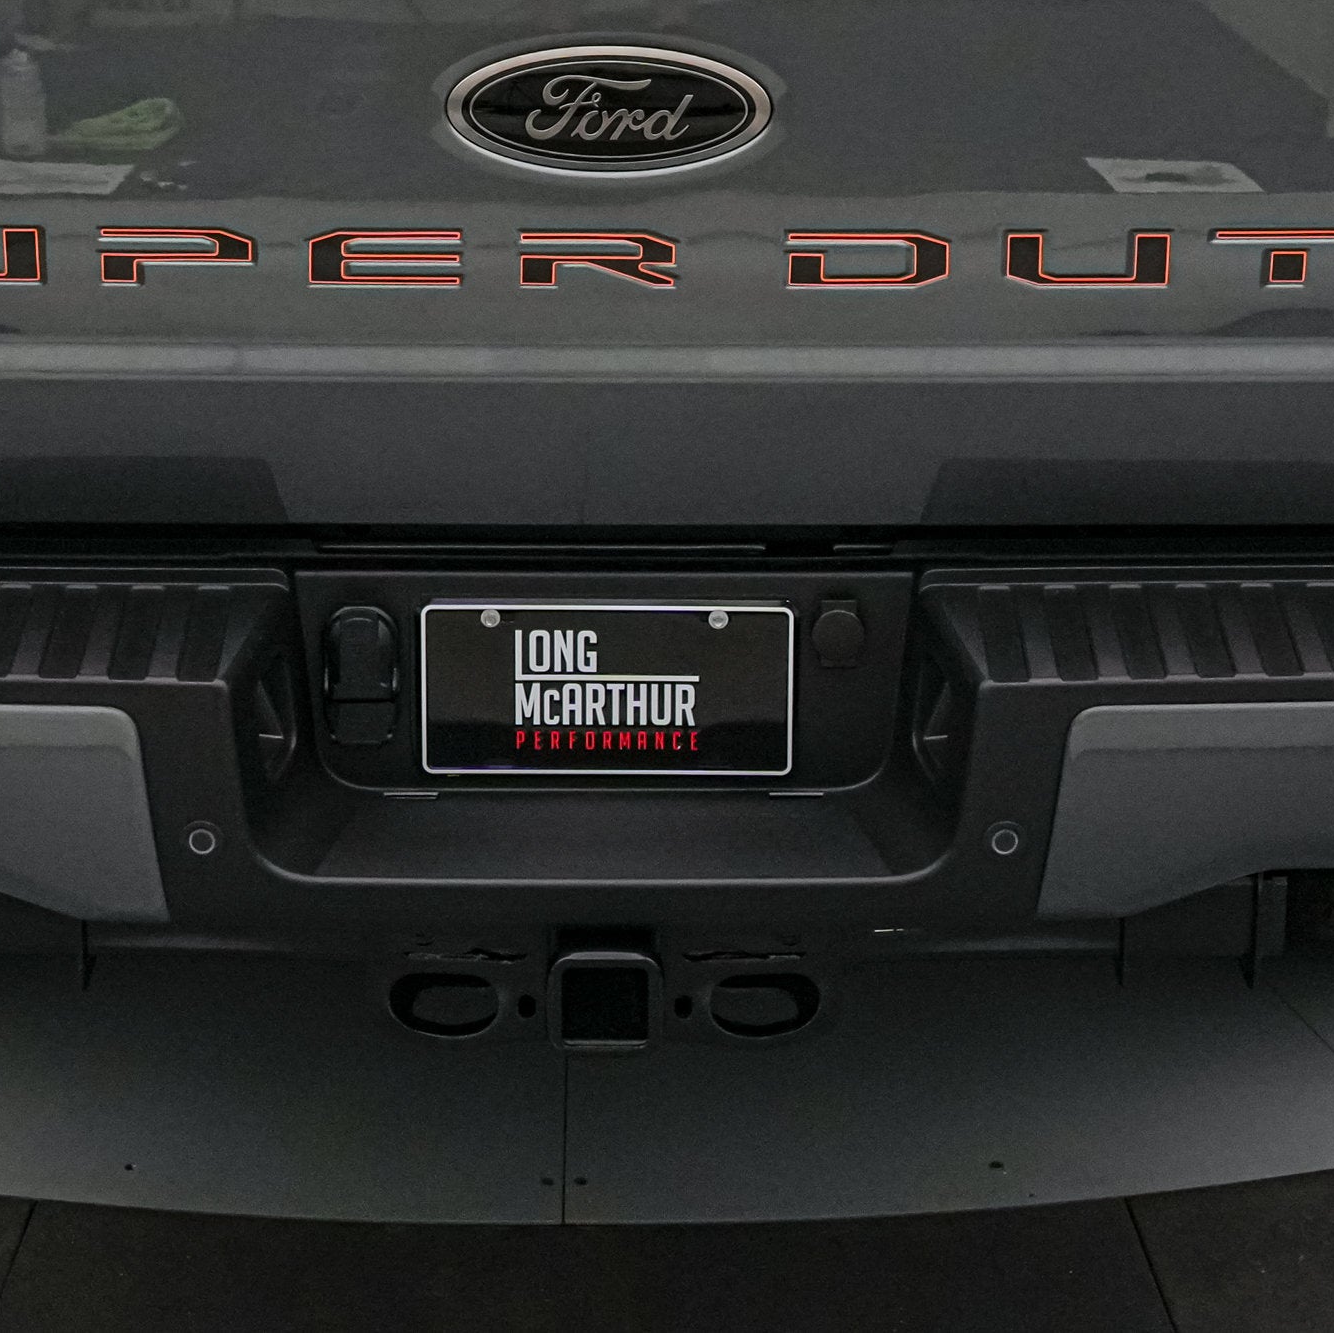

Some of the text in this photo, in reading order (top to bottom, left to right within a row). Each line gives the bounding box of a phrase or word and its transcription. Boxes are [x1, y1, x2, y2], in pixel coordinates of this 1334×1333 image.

[525, 74, 694, 141] Ford
[514, 629, 598, 680] LONG
[514, 682, 696, 727] McARTHUR
[515, 730, 699, 751] PERFORMANCE
